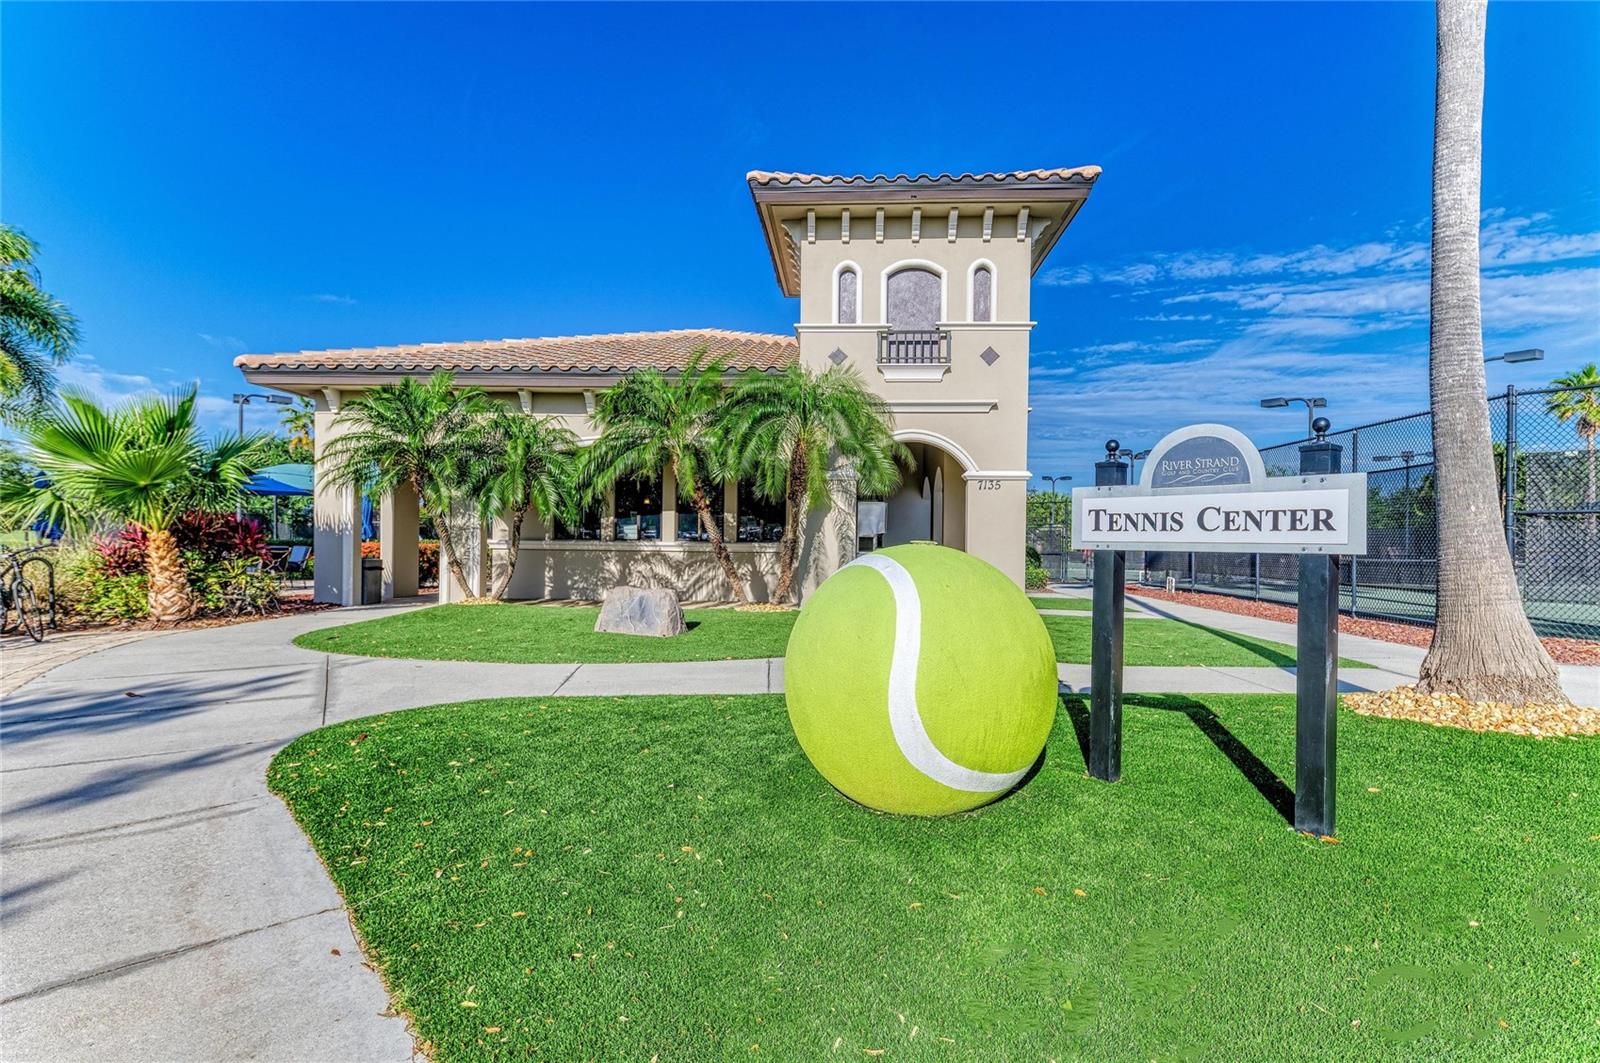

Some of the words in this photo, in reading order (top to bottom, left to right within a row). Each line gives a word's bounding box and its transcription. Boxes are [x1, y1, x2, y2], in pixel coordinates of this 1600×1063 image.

[1162, 460, 1193, 472] RIVER
[1195, 456, 1239, 469] STRAND
[976, 480, 1001, 490] 7135
[1088, 508, 1184, 533] TENNIS
[1196, 506, 1337, 533] CENTER
